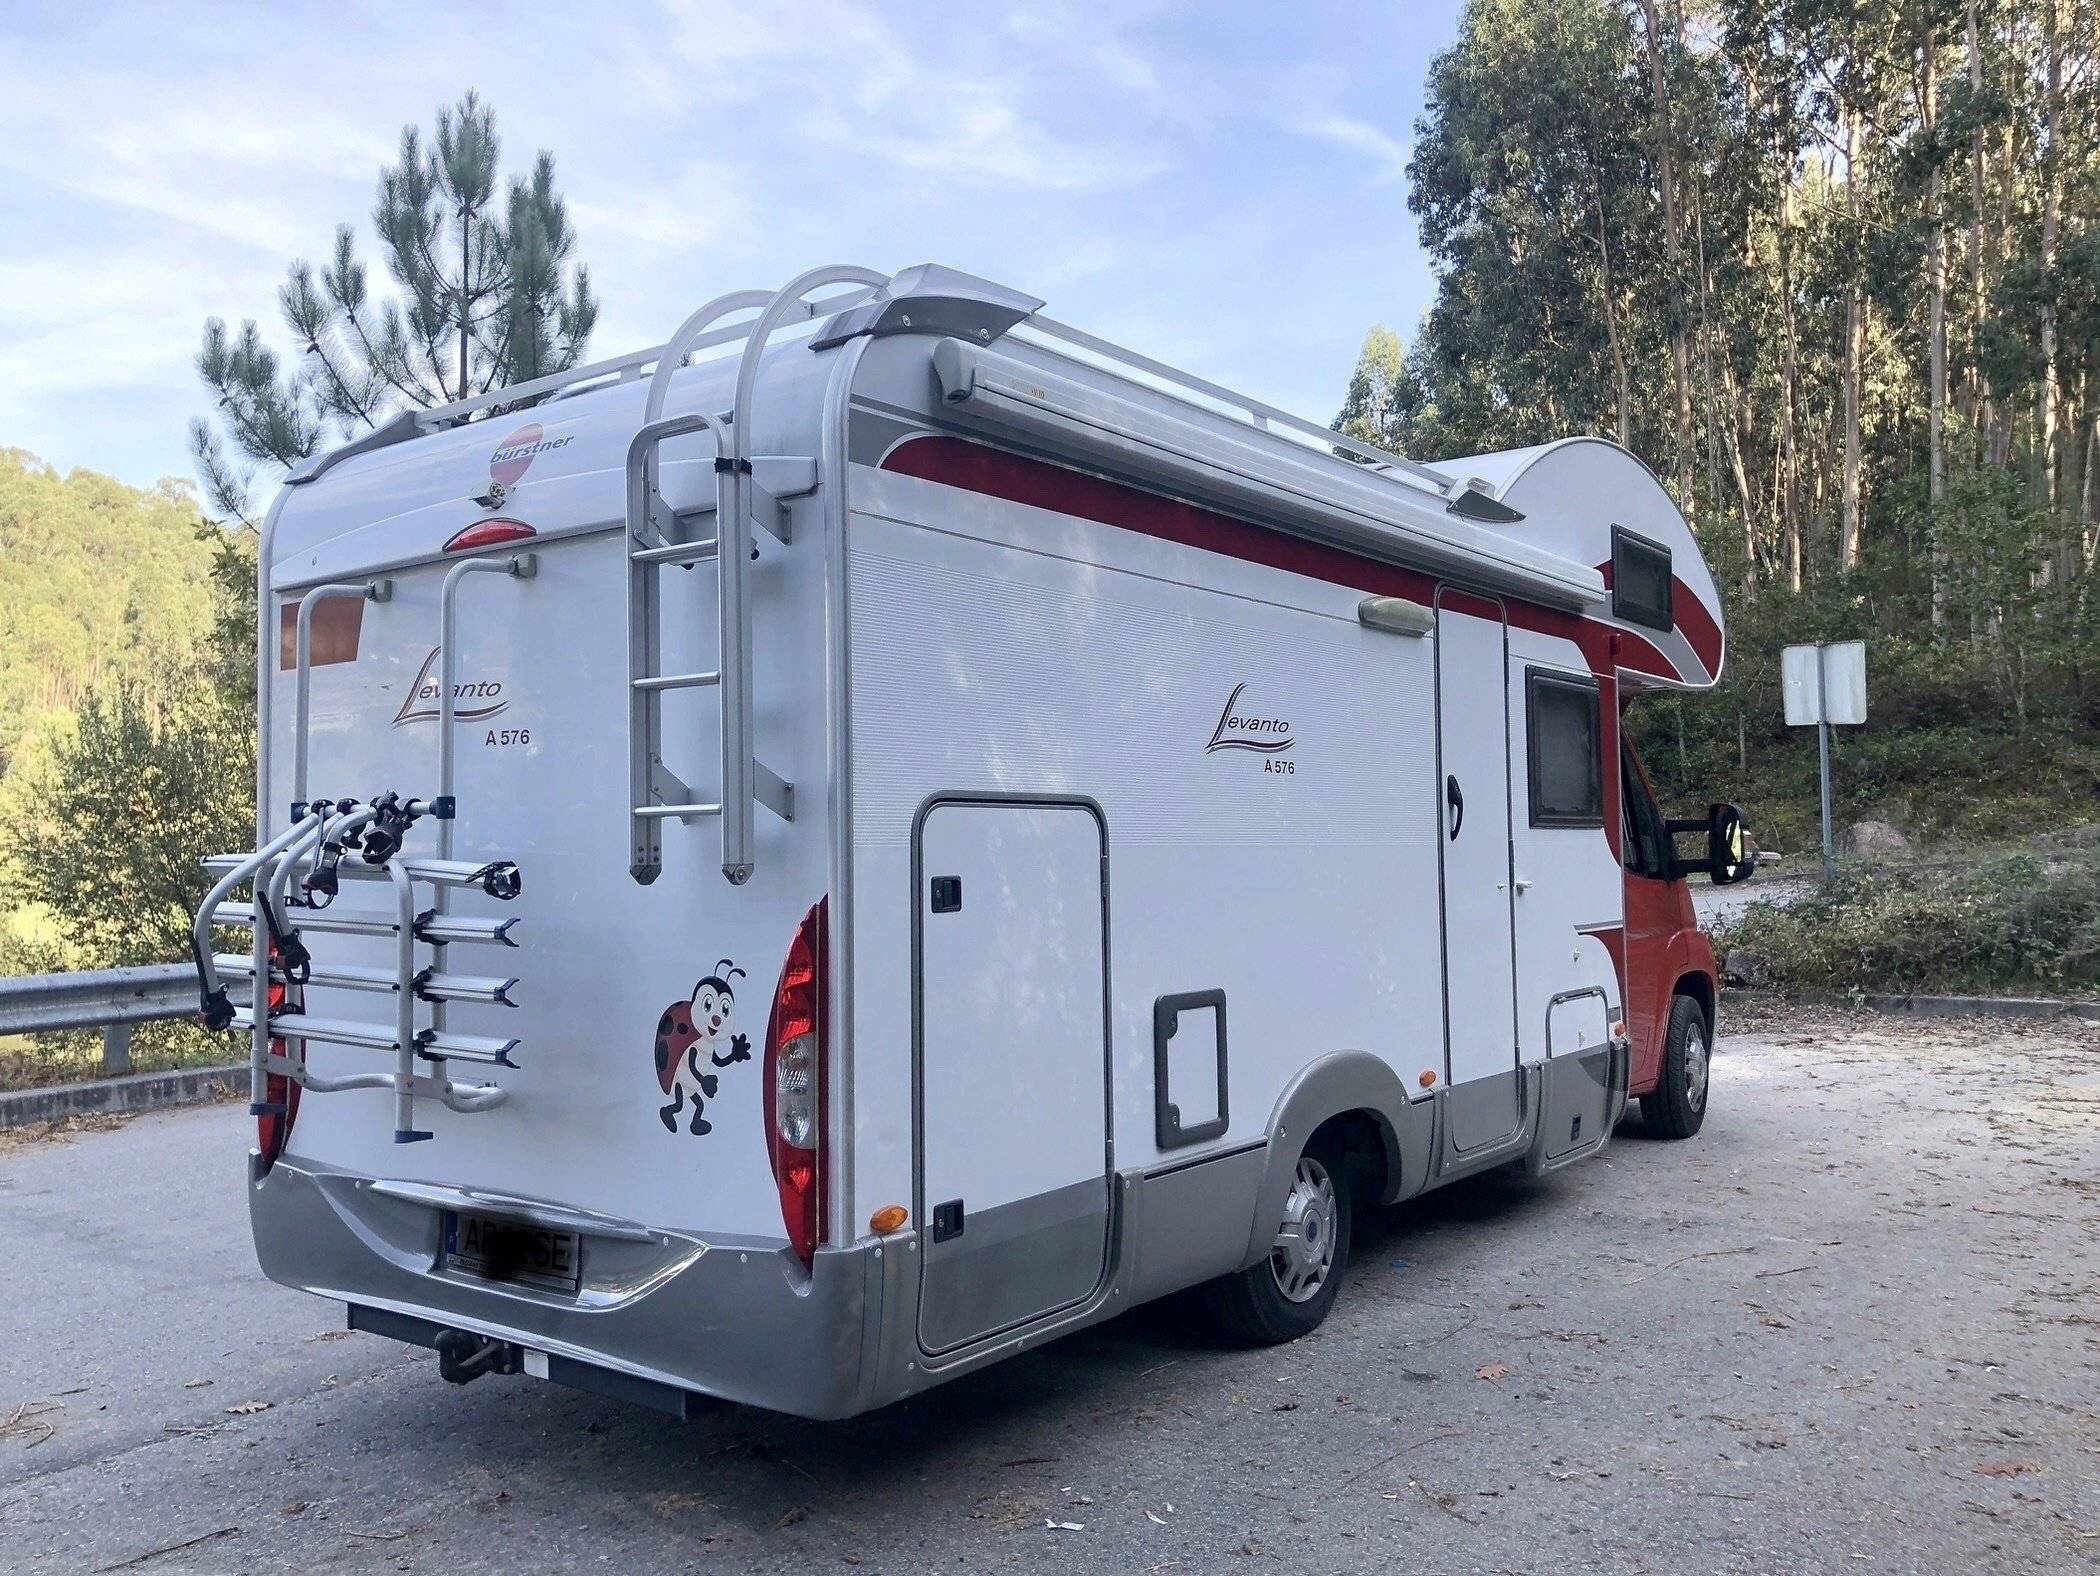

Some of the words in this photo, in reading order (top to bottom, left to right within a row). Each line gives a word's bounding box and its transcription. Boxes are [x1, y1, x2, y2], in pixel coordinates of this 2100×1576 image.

[490, 435, 575, 464] bürstner
[390, 645, 511, 729] Leanto
[1204, 681, 1296, 754] Levanto
[485, 729, 497, 746] A
[500, 729, 530, 745] 576
[1264, 759, 1273, 774] A
[1274, 760, 1295, 775] 576
